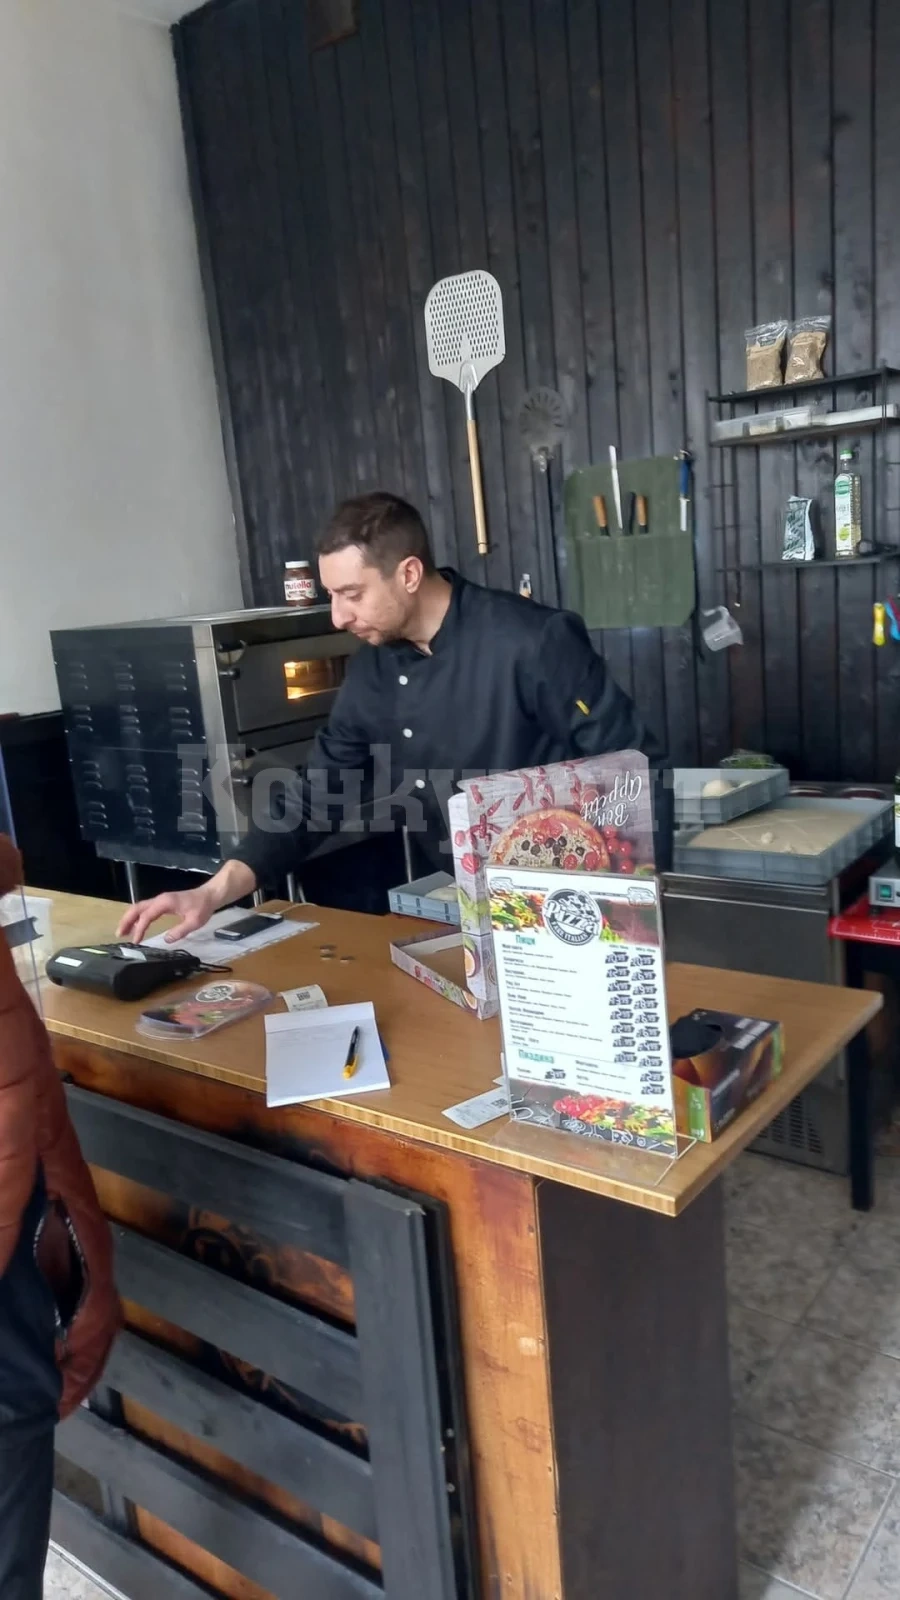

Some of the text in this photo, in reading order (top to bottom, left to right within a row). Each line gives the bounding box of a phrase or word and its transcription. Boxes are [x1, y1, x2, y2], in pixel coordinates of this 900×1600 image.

[285, 581, 312, 590] nutella
[593, 803, 629, 826] Bon
[543, 899, 600, 936] Pizza
